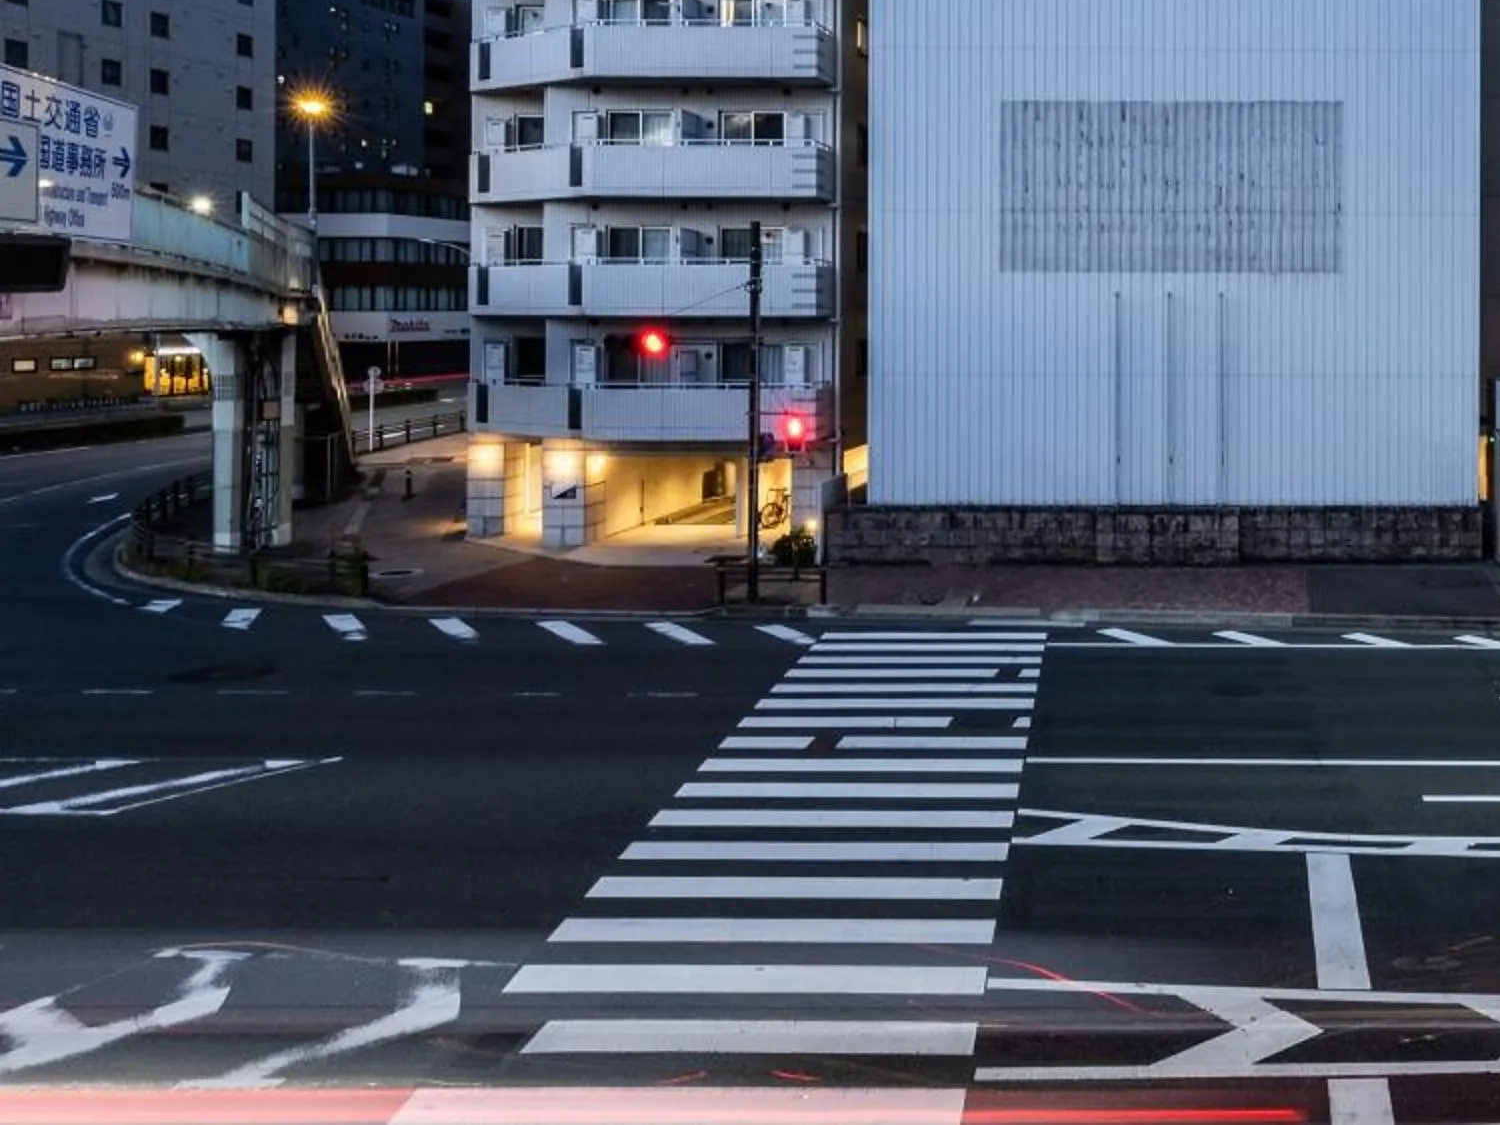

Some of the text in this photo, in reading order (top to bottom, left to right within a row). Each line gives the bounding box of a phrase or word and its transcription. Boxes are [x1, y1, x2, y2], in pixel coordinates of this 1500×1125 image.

[1, 80, 101, 139] 国土交通省
